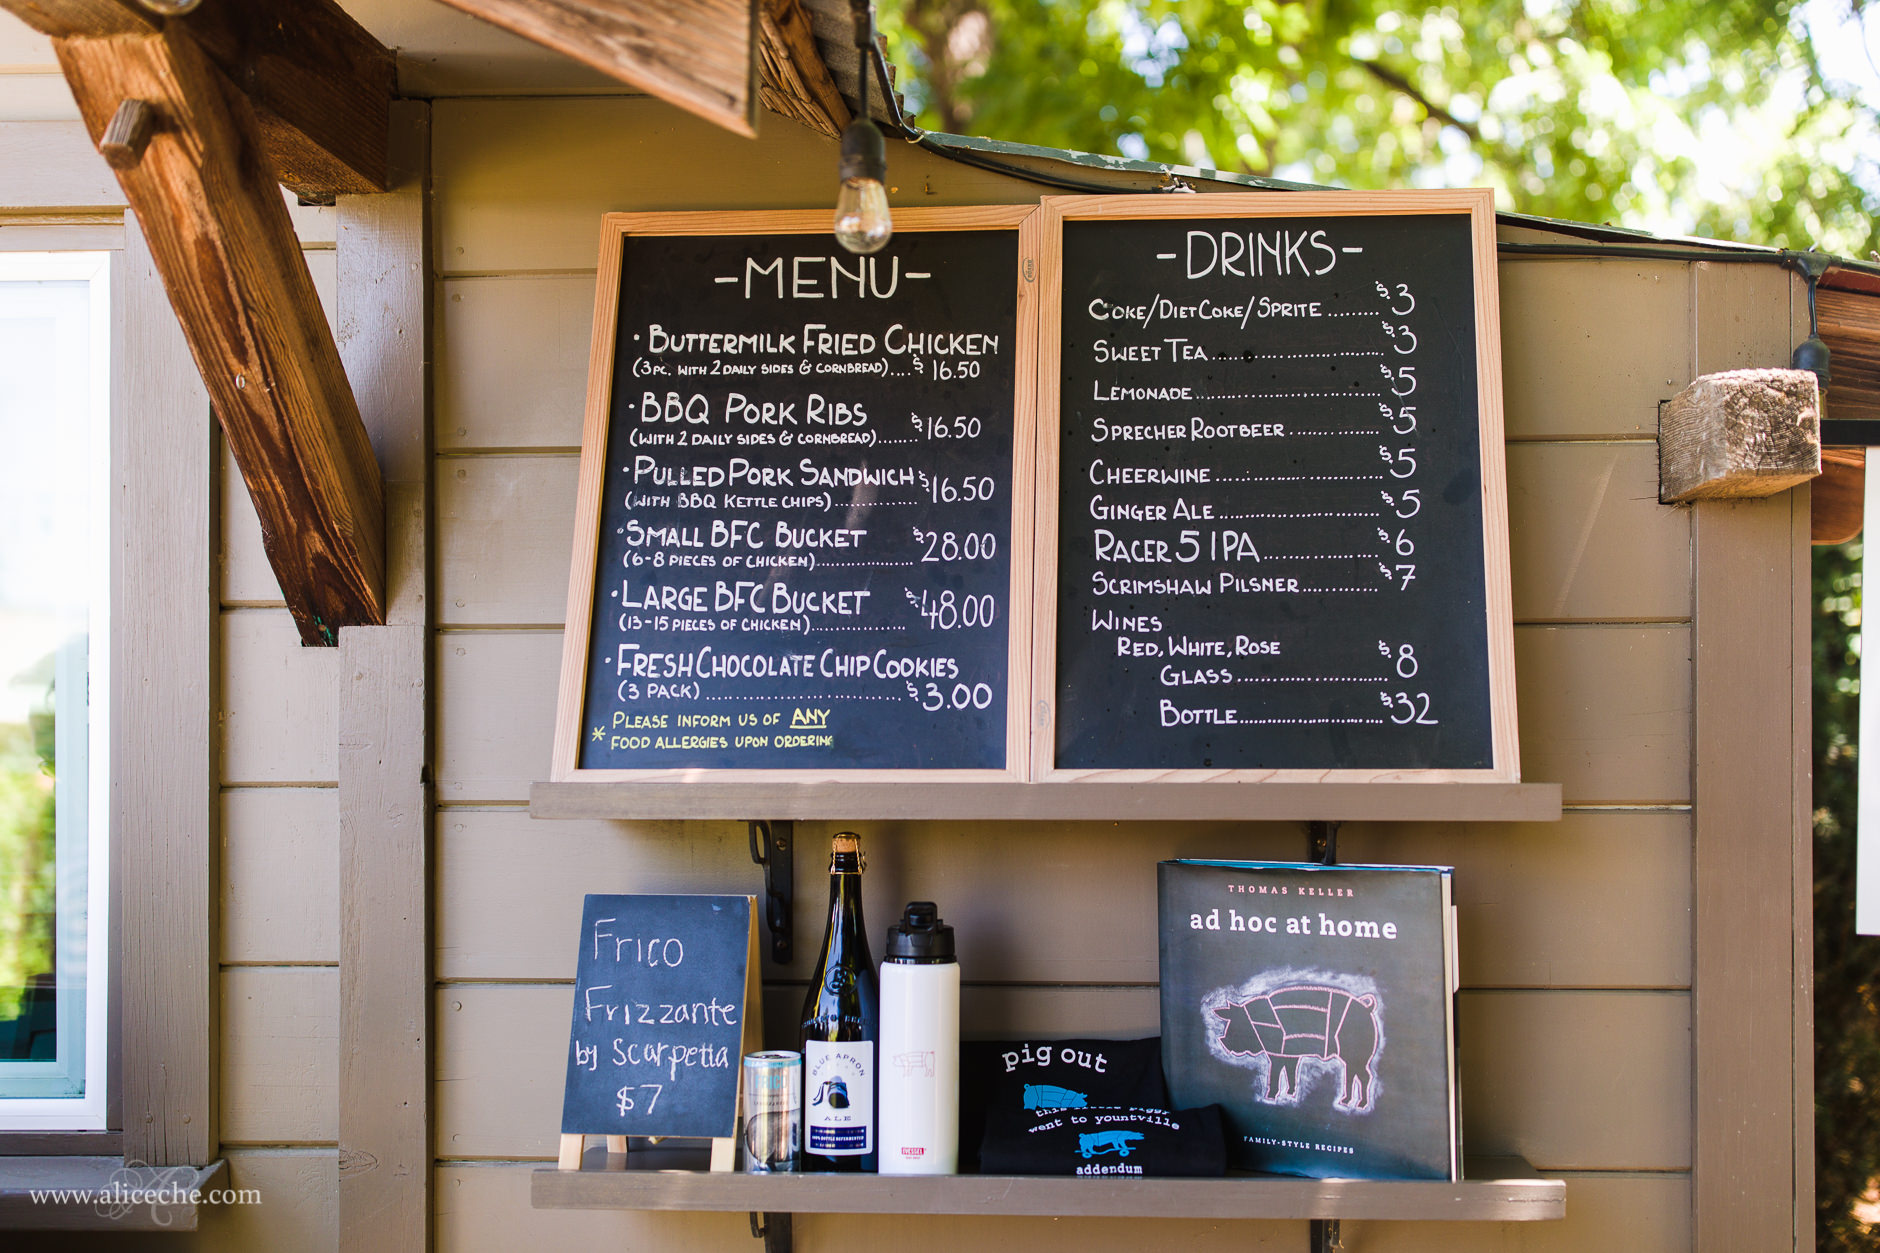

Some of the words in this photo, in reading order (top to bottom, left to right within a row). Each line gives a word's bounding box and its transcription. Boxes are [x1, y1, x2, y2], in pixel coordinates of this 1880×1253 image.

[648, 323, 796, 355] BUTTERMILK
[803, 323, 876, 356] FRIED
[884, 323, 999, 356] CHICKEN
[1093, 339, 1162, 363] SWEET
[1163, 338, 1209, 363] TEA
[677, 364, 708, 376] WITH
[722, 364, 757, 375] DAILY
[760, 363, 794, 375] SIDES
[798, 358, 813, 375] &
[1093, 379, 1193, 401] LEMONADE
[641, 391, 710, 425] BBQ
[725, 392, 798, 426] PORK
[806, 393, 868, 427] RIBS
[691, 433, 733, 446] DAILY
[736, 433, 776, 445] SIDES
[778, 429, 794, 446] &
[1090, 417, 1187, 443] SPRECHER
[1191, 416, 1285, 442] ROOTBEER
[633, 455, 726, 488] PULLED
[728, 457, 794, 487] PORK
[799, 458, 915, 488] SANDWICH
[1089, 458, 1211, 485] CHEERWINE
[677, 492, 717, 509] BBQ
[724, 493, 779, 509] KETTLE
[1089, 494, 1167, 522] GINGER
[1172, 497, 1215, 521] ALE
[626, 519, 705, 548] SMALL
[710, 519, 764, 549] BFC
[775, 520, 868, 549] BUCKET
[1094, 528, 1173, 564] RACER
[1175, 529, 1200, 563] 5
[1210, 530, 1261, 563] IPA
[668, 554, 717, 567] PIECES
[723, 554, 741, 567] OF
[1091, 570, 1212, 596] SCRIMSHAW
[1219, 572, 1300, 594] PILSNER
[621, 579, 708, 612] LARGE
[714, 580, 766, 614] BFC
[772, 582, 871, 615] BUCKET
[671, 618, 716, 632] PIECES
[720, 618, 738, 631] OF
[1091, 608, 1163, 633] WINES
[1117, 636, 1164, 658] RED,
[1168, 635, 1233, 658] WHITE,
[1235, 634, 1281, 656] ROSE
[616, 643, 694, 679] FRESH
[695, 645, 816, 679] CHOCOLATE
[819, 648, 871, 678] CHIP
[873, 648, 960, 680] COOKIES
[1160, 664, 1233, 686] GLASS
[612, 711, 669, 729] PLEASE
[677, 714, 731, 728] INFORM
[738, 713, 758, 727] US
[762, 712, 781, 726] OF
[789, 707, 831, 730] ANY
[1159, 698, 1238, 727] BOTTLE
[611, 735, 651, 750] FOOD
[654, 735, 729, 750] ALLERGIES
[734, 735, 769, 748] UPON
[1227, 884, 1290, 897] THOMAS
[1297, 886, 1356, 899] KELLER
[1190, 908, 1221, 930] ad
[1228, 909, 1277, 933] hoc
[1286, 915, 1311, 935] at
[1318, 912, 1398, 940] home
[594, 917, 684, 968] Frico
[585, 984, 737, 1026] Frizzante
[575, 1040, 598, 1072] by
[612, 1038, 729, 1082] Scarpetta
[811, 1053, 831, 1077] BLUE
[835, 1052, 865, 1077] APRON
[1001, 1043, 1053, 1073] pig
[1060, 1048, 1108, 1073] out
[616, 1083, 663, 1117] $7
[1028, 1118, 1063, 1134] went
[1071, 1115, 1088, 1124] to
[1095, 1114, 1180, 1130] yountville
[1243, 1136, 1310, 1149] FAMILY-STYLE
[1315, 1143, 1354, 1154] RECIPES
[1076, 1162, 1143, 1175] addendum
